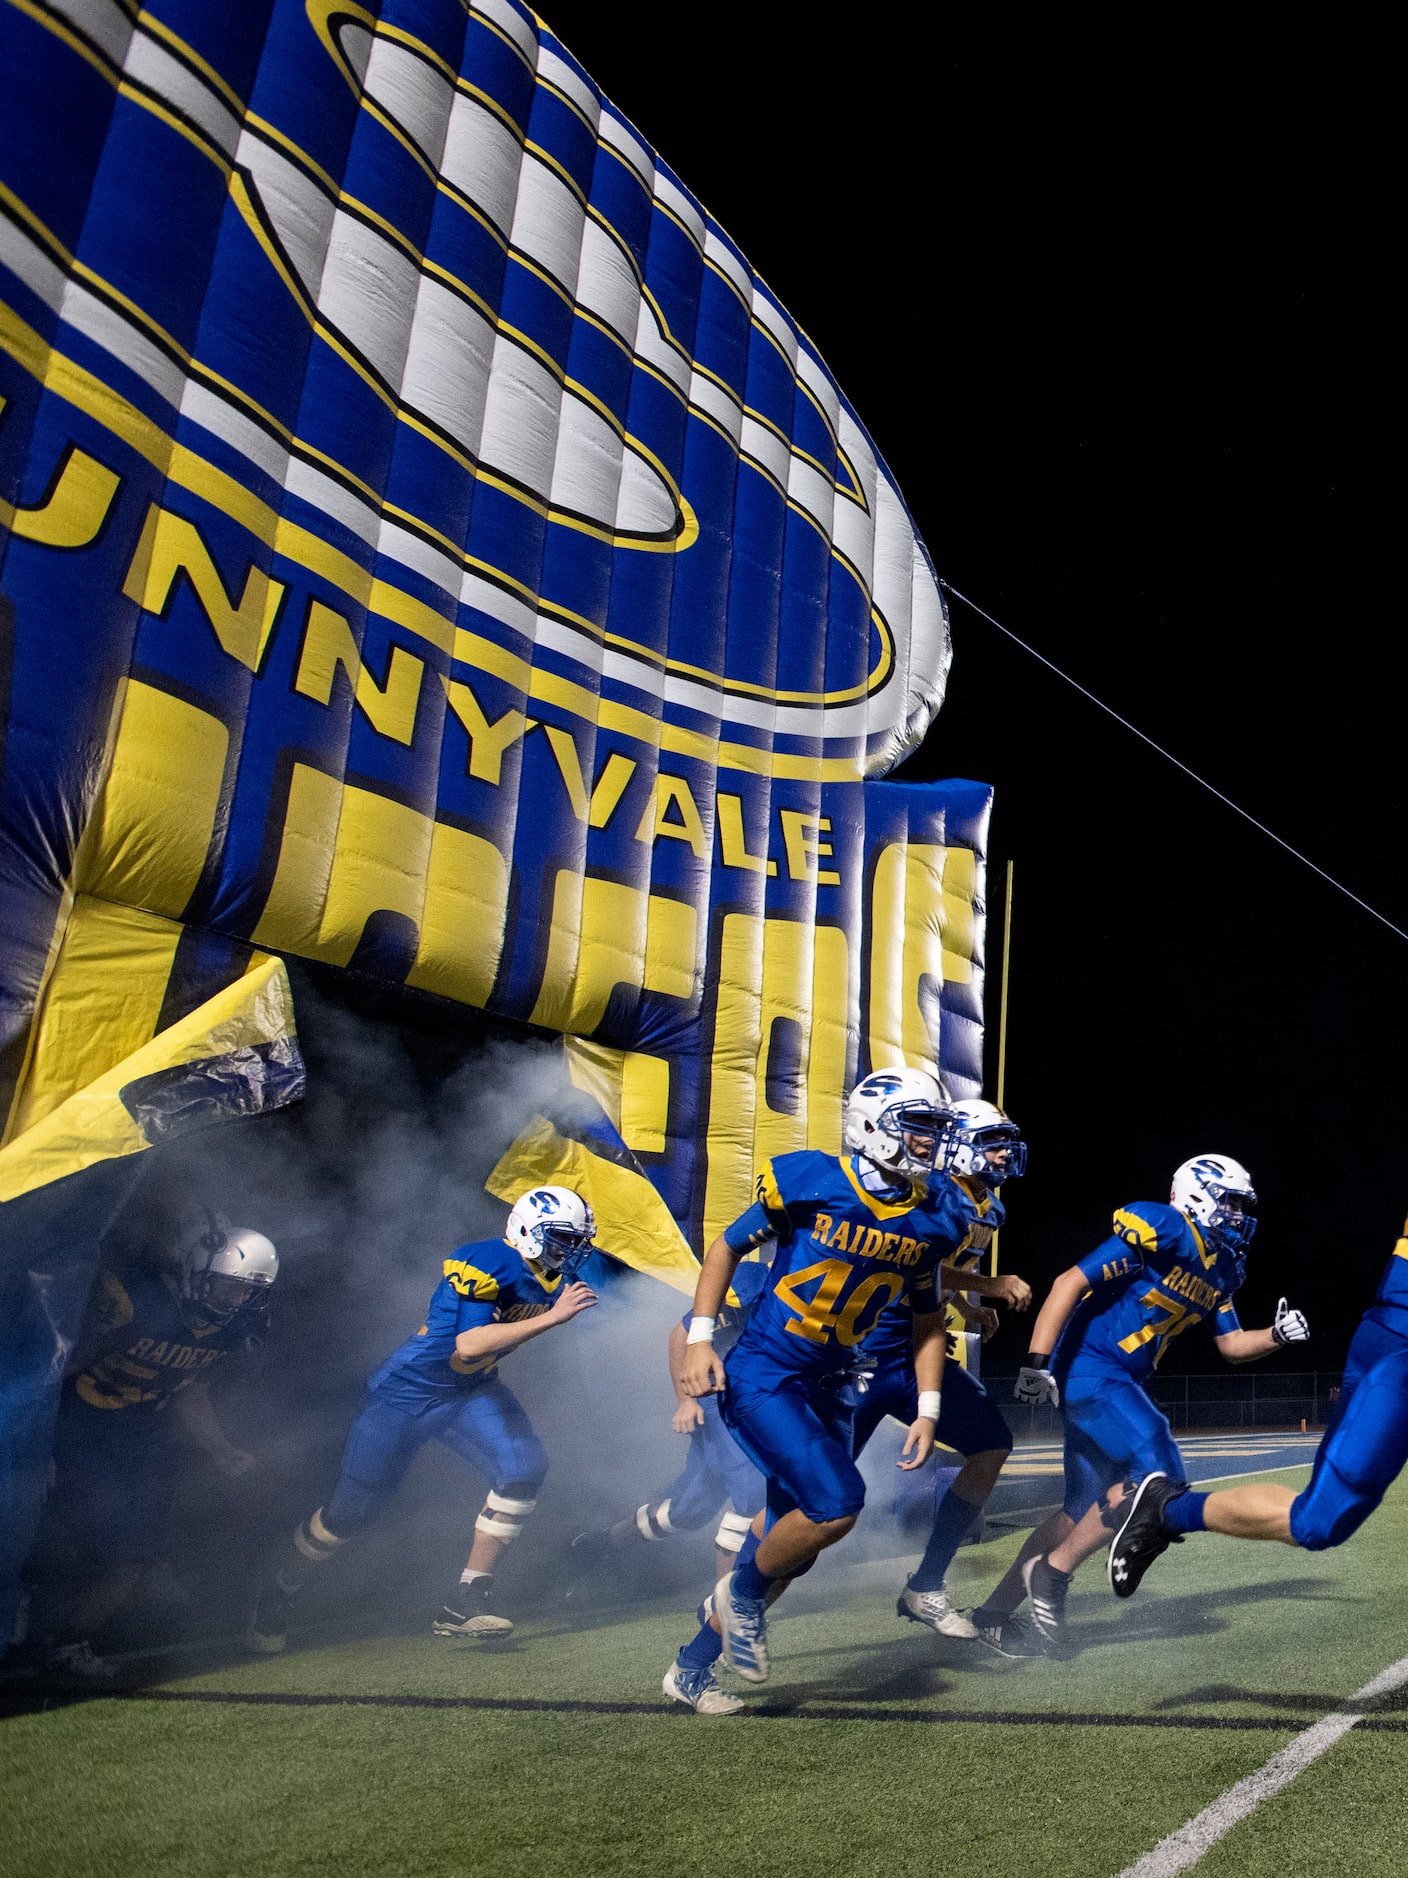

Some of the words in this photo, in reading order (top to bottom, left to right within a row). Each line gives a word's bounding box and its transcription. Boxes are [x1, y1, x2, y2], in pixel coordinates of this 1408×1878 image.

[0, 394, 840, 887] UNNYVALE
[811, 1212, 930, 1268] RAIDERS
[1103, 1257, 1132, 1282] ALL
[773, 1257, 905, 1346] 40
